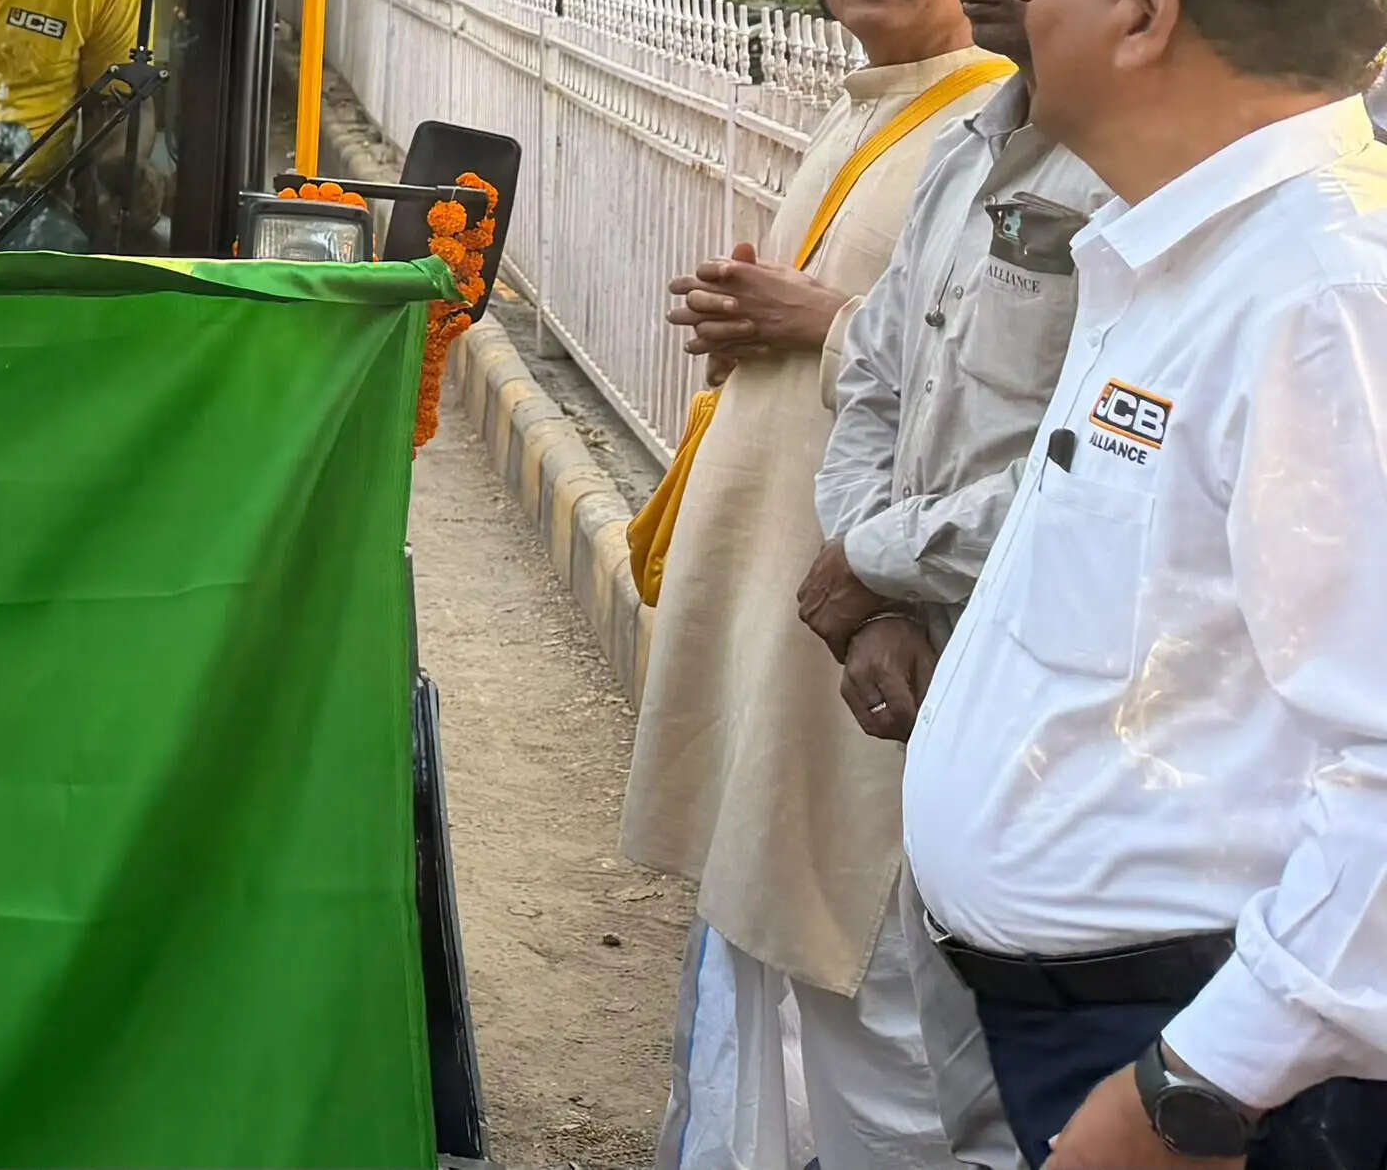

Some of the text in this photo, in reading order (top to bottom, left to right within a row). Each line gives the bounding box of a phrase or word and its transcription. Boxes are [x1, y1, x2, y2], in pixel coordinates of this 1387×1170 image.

[8, 10, 64, 37] JCB
[986, 263, 1041, 294] ALLIANCE
[1096, 387, 1166, 441] JCB
